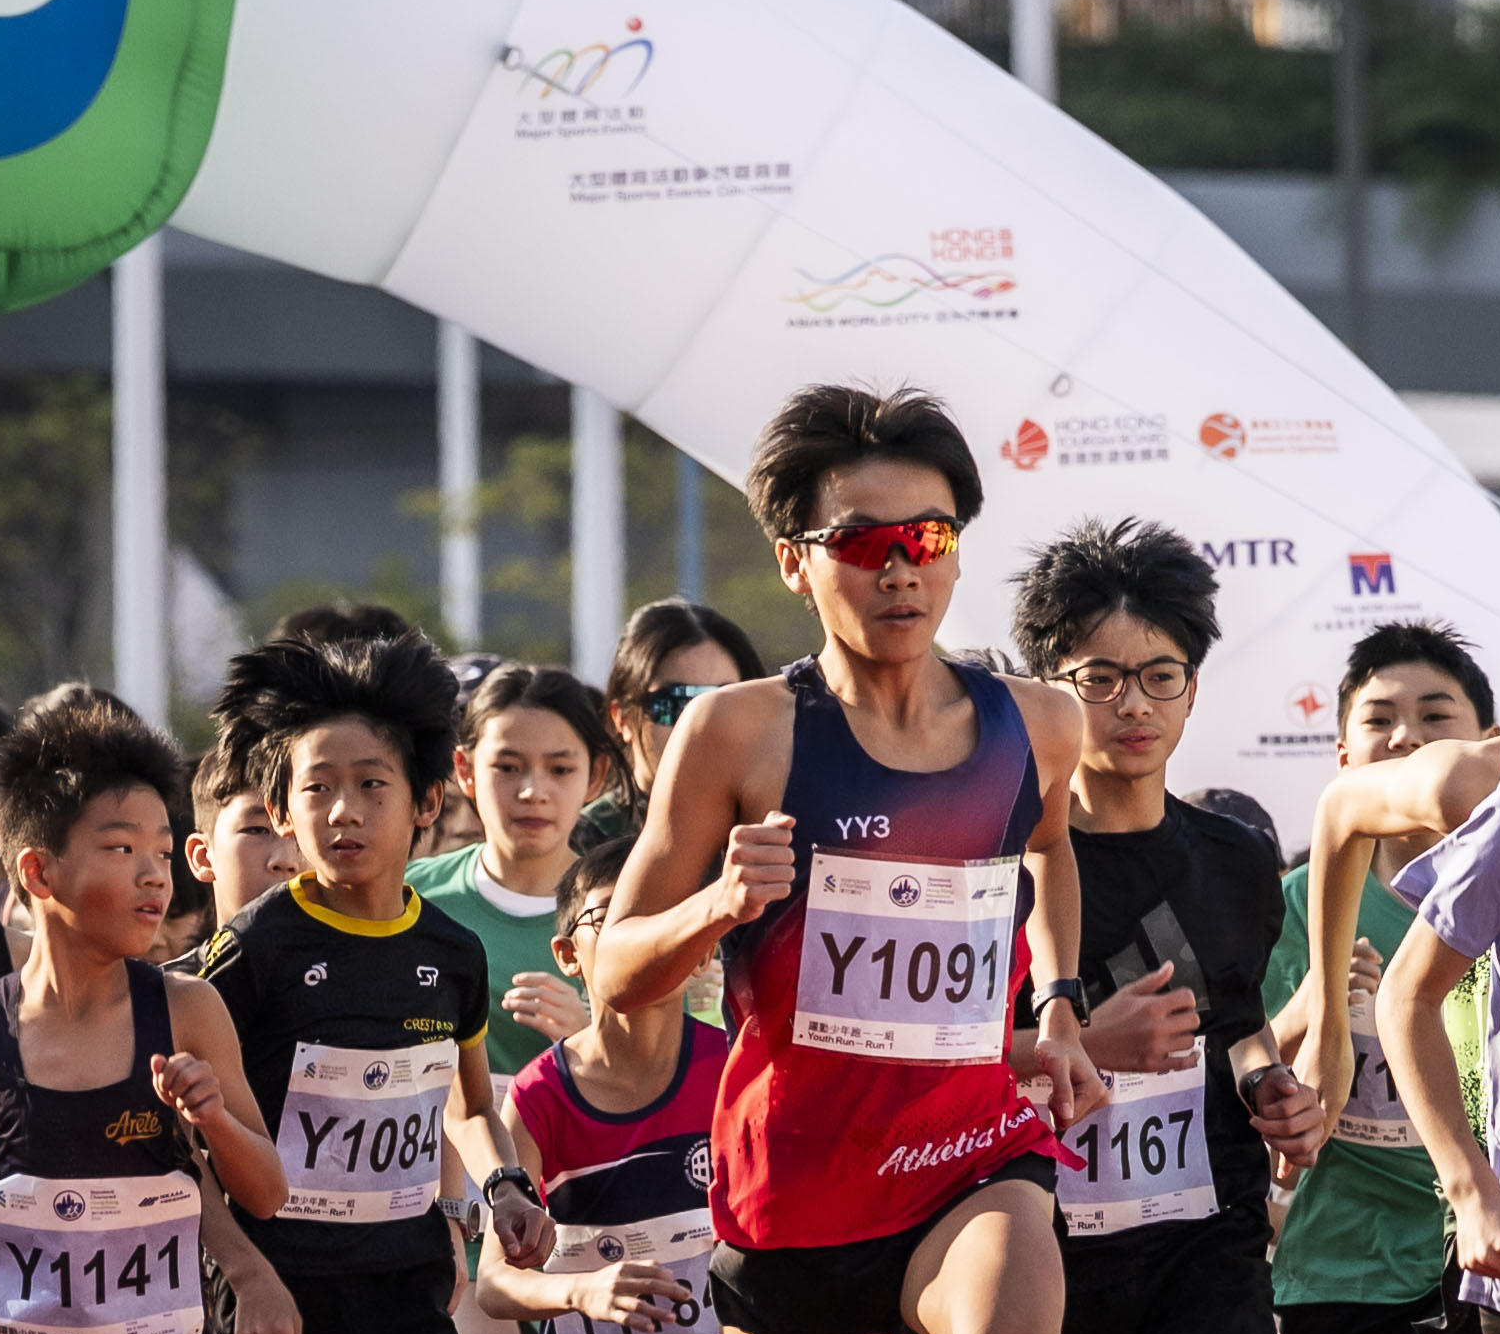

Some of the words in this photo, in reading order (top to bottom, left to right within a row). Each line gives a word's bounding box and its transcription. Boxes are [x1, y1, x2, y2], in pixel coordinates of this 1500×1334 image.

[929, 227, 995, 245] HONG
[930, 245, 996, 262] KONG
[1202, 538, 1298, 567] MTR
[835, 815, 891, 840] YY3
[820, 931, 997, 1004] Y1091
[807, 1032, 834, 1044] Youth
[835, 1034, 855, 1047] Run
[865, 1038, 886, 1050] Run
[888, 1039, 894, 1050] 1
[297, 1105, 438, 1174] Y1084
[876, 1127, 993, 1177] Athletics
[303, 1207, 322, 1217] Run
[329, 1208, 347, 1217] Run
[1077, 1220, 1096, 1230] Run
[1099, 1221, 1104, 1230] 1
[5, 1234, 180, 1309] Y1141
